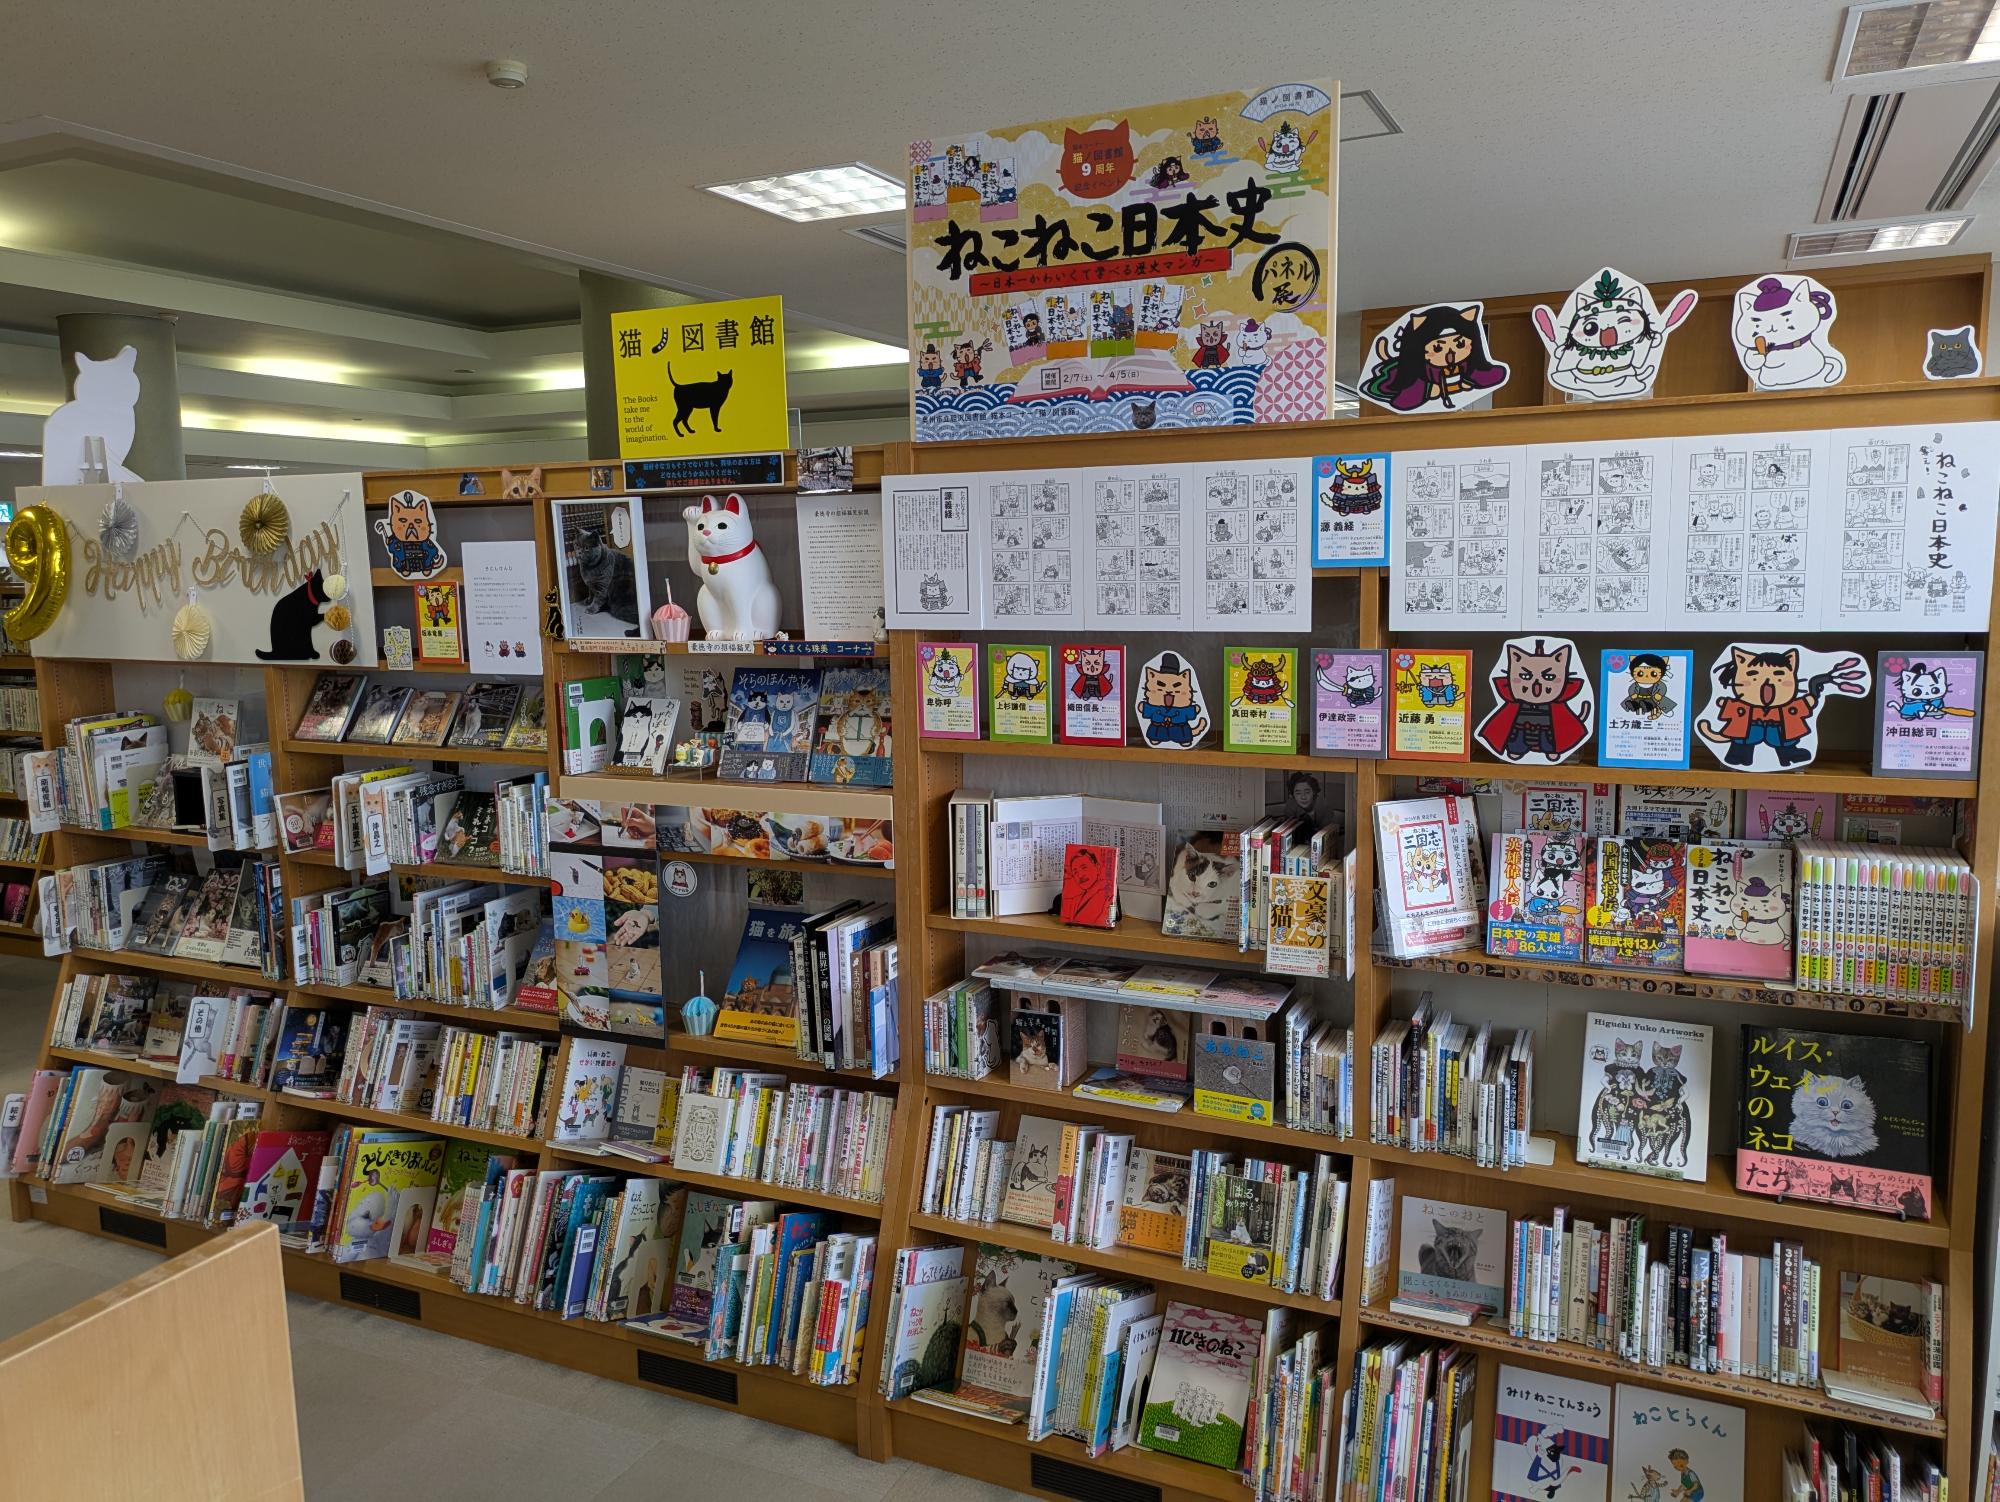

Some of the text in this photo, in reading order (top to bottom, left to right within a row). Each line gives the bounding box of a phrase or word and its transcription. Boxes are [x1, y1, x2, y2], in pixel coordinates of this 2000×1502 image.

[935, 177, 1282, 281] ねこねこ日本史
[1261, 256, 1314, 284] パネル
[1271, 282, 1302, 305] 展
[618, 314, 775, 359] 猫ノ図書館
[1926, 451, 1957, 569] ねこねこ日本史
[738, 672, 812, 693] そらのほんやさん
[996, 701, 1026, 711] 上杉謙信
[1067, 703, 1100, 713] 織田信長
[1231, 709, 1268, 719] 真田幸村
[1318, 712, 1356, 723] 伊達政宗
[1608, 719, 1654, 730] 土方歳三
[1885, 726, 1938, 738] 沖田総司
[1530, 798, 1580, 813] 三国志
[1403, 831, 1442, 850] 三国志
[1504, 836, 1524, 907] 英雄偉人伝
[1602, 841, 1618, 912] 戦国武将伝
[1710, 847, 1735, 915] ねこねこ
[1689, 870, 1712, 922] 日本史
[1271, 904, 1293, 928] 猫
[1491, 927, 1561, 943] 日本史の英雄
[1588, 934, 1667, 951] 戦国武将13人の
[1594, 1017, 1705, 1038] Higuchi Yuko Artworks
[617, 1066, 632, 1124] SCIENCE
[1749, 1096, 1775, 1119] の
[1748, 1127, 1794, 1152] ネコ
[1745, 1164, 1793, 1193] たち
[1168, 1327, 1246, 1360] 11ぴきのねこ
[1506, 1385, 1602, 1419] みけねこてんちょう
[1632, 1405, 1728, 1439] ねことらくん
